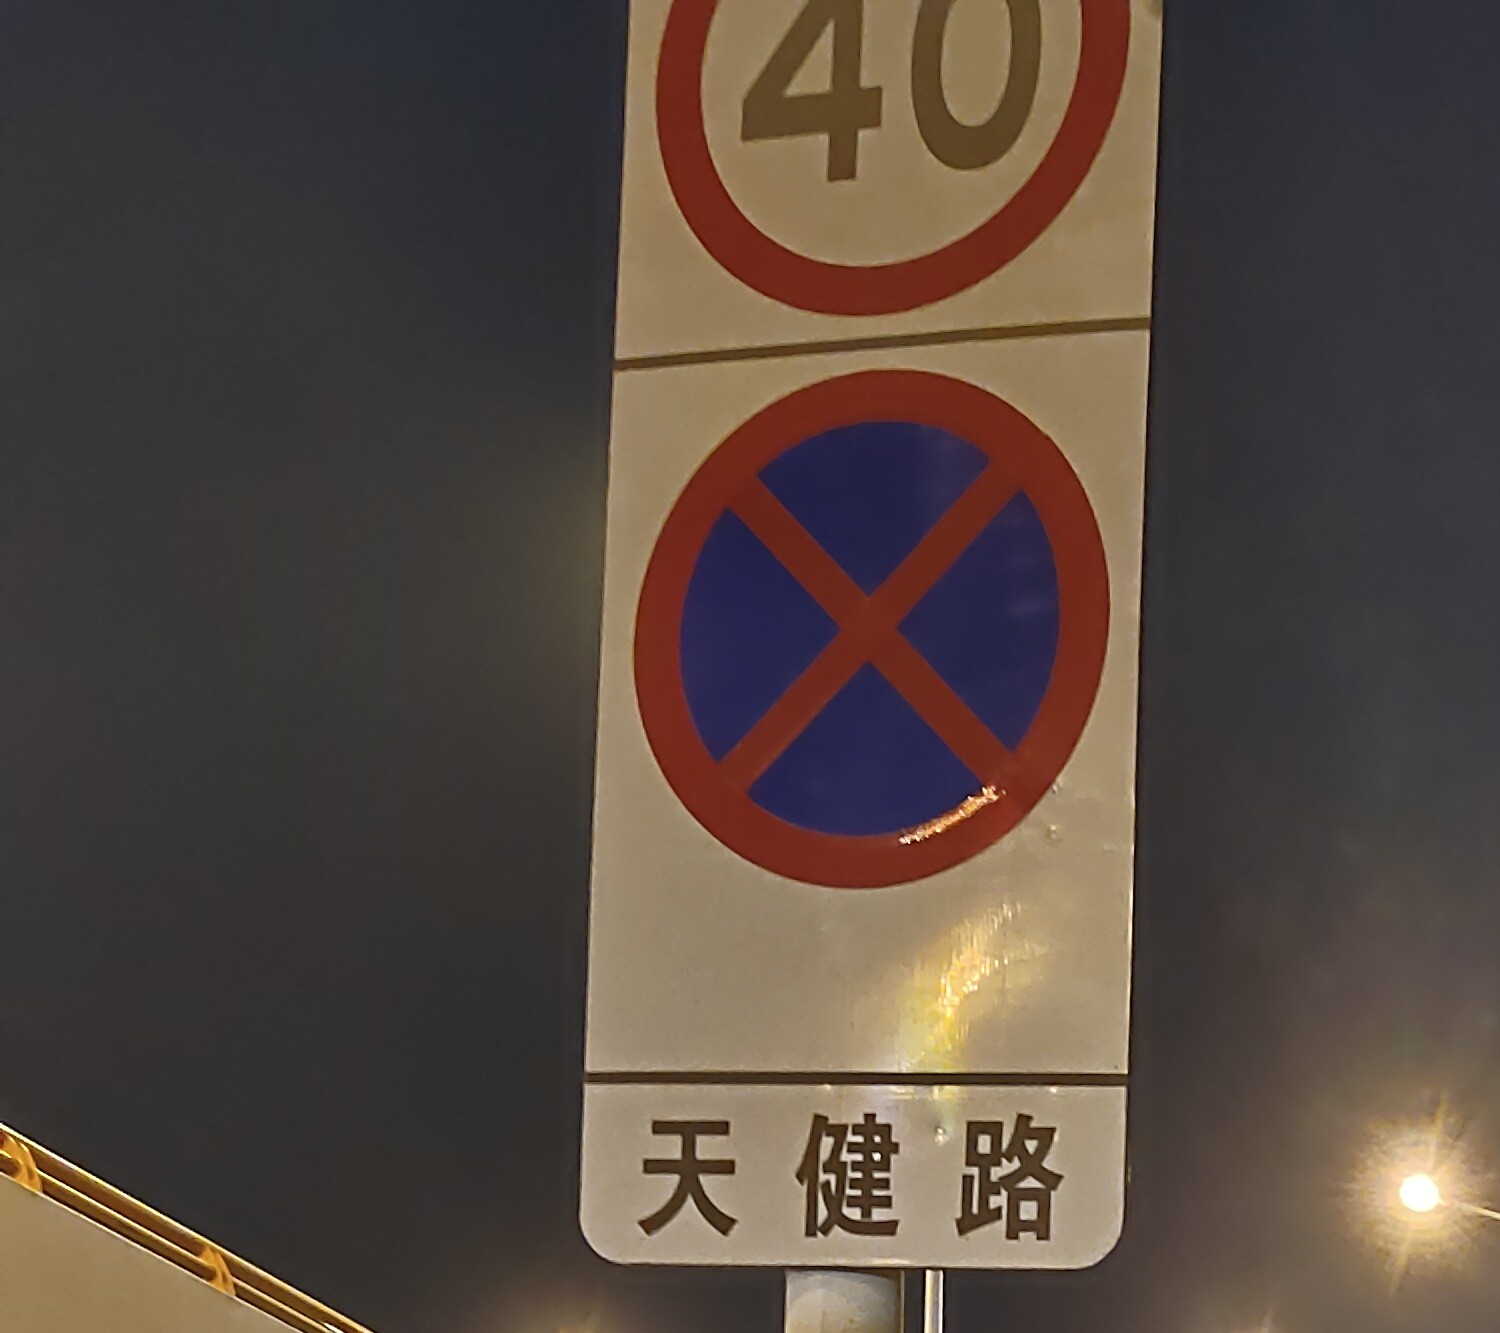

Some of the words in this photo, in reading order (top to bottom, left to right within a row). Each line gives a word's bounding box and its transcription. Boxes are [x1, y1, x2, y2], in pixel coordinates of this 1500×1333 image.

[741, 0, 1042, 182] 40
[637, 1112, 1065, 1241] 天健路
